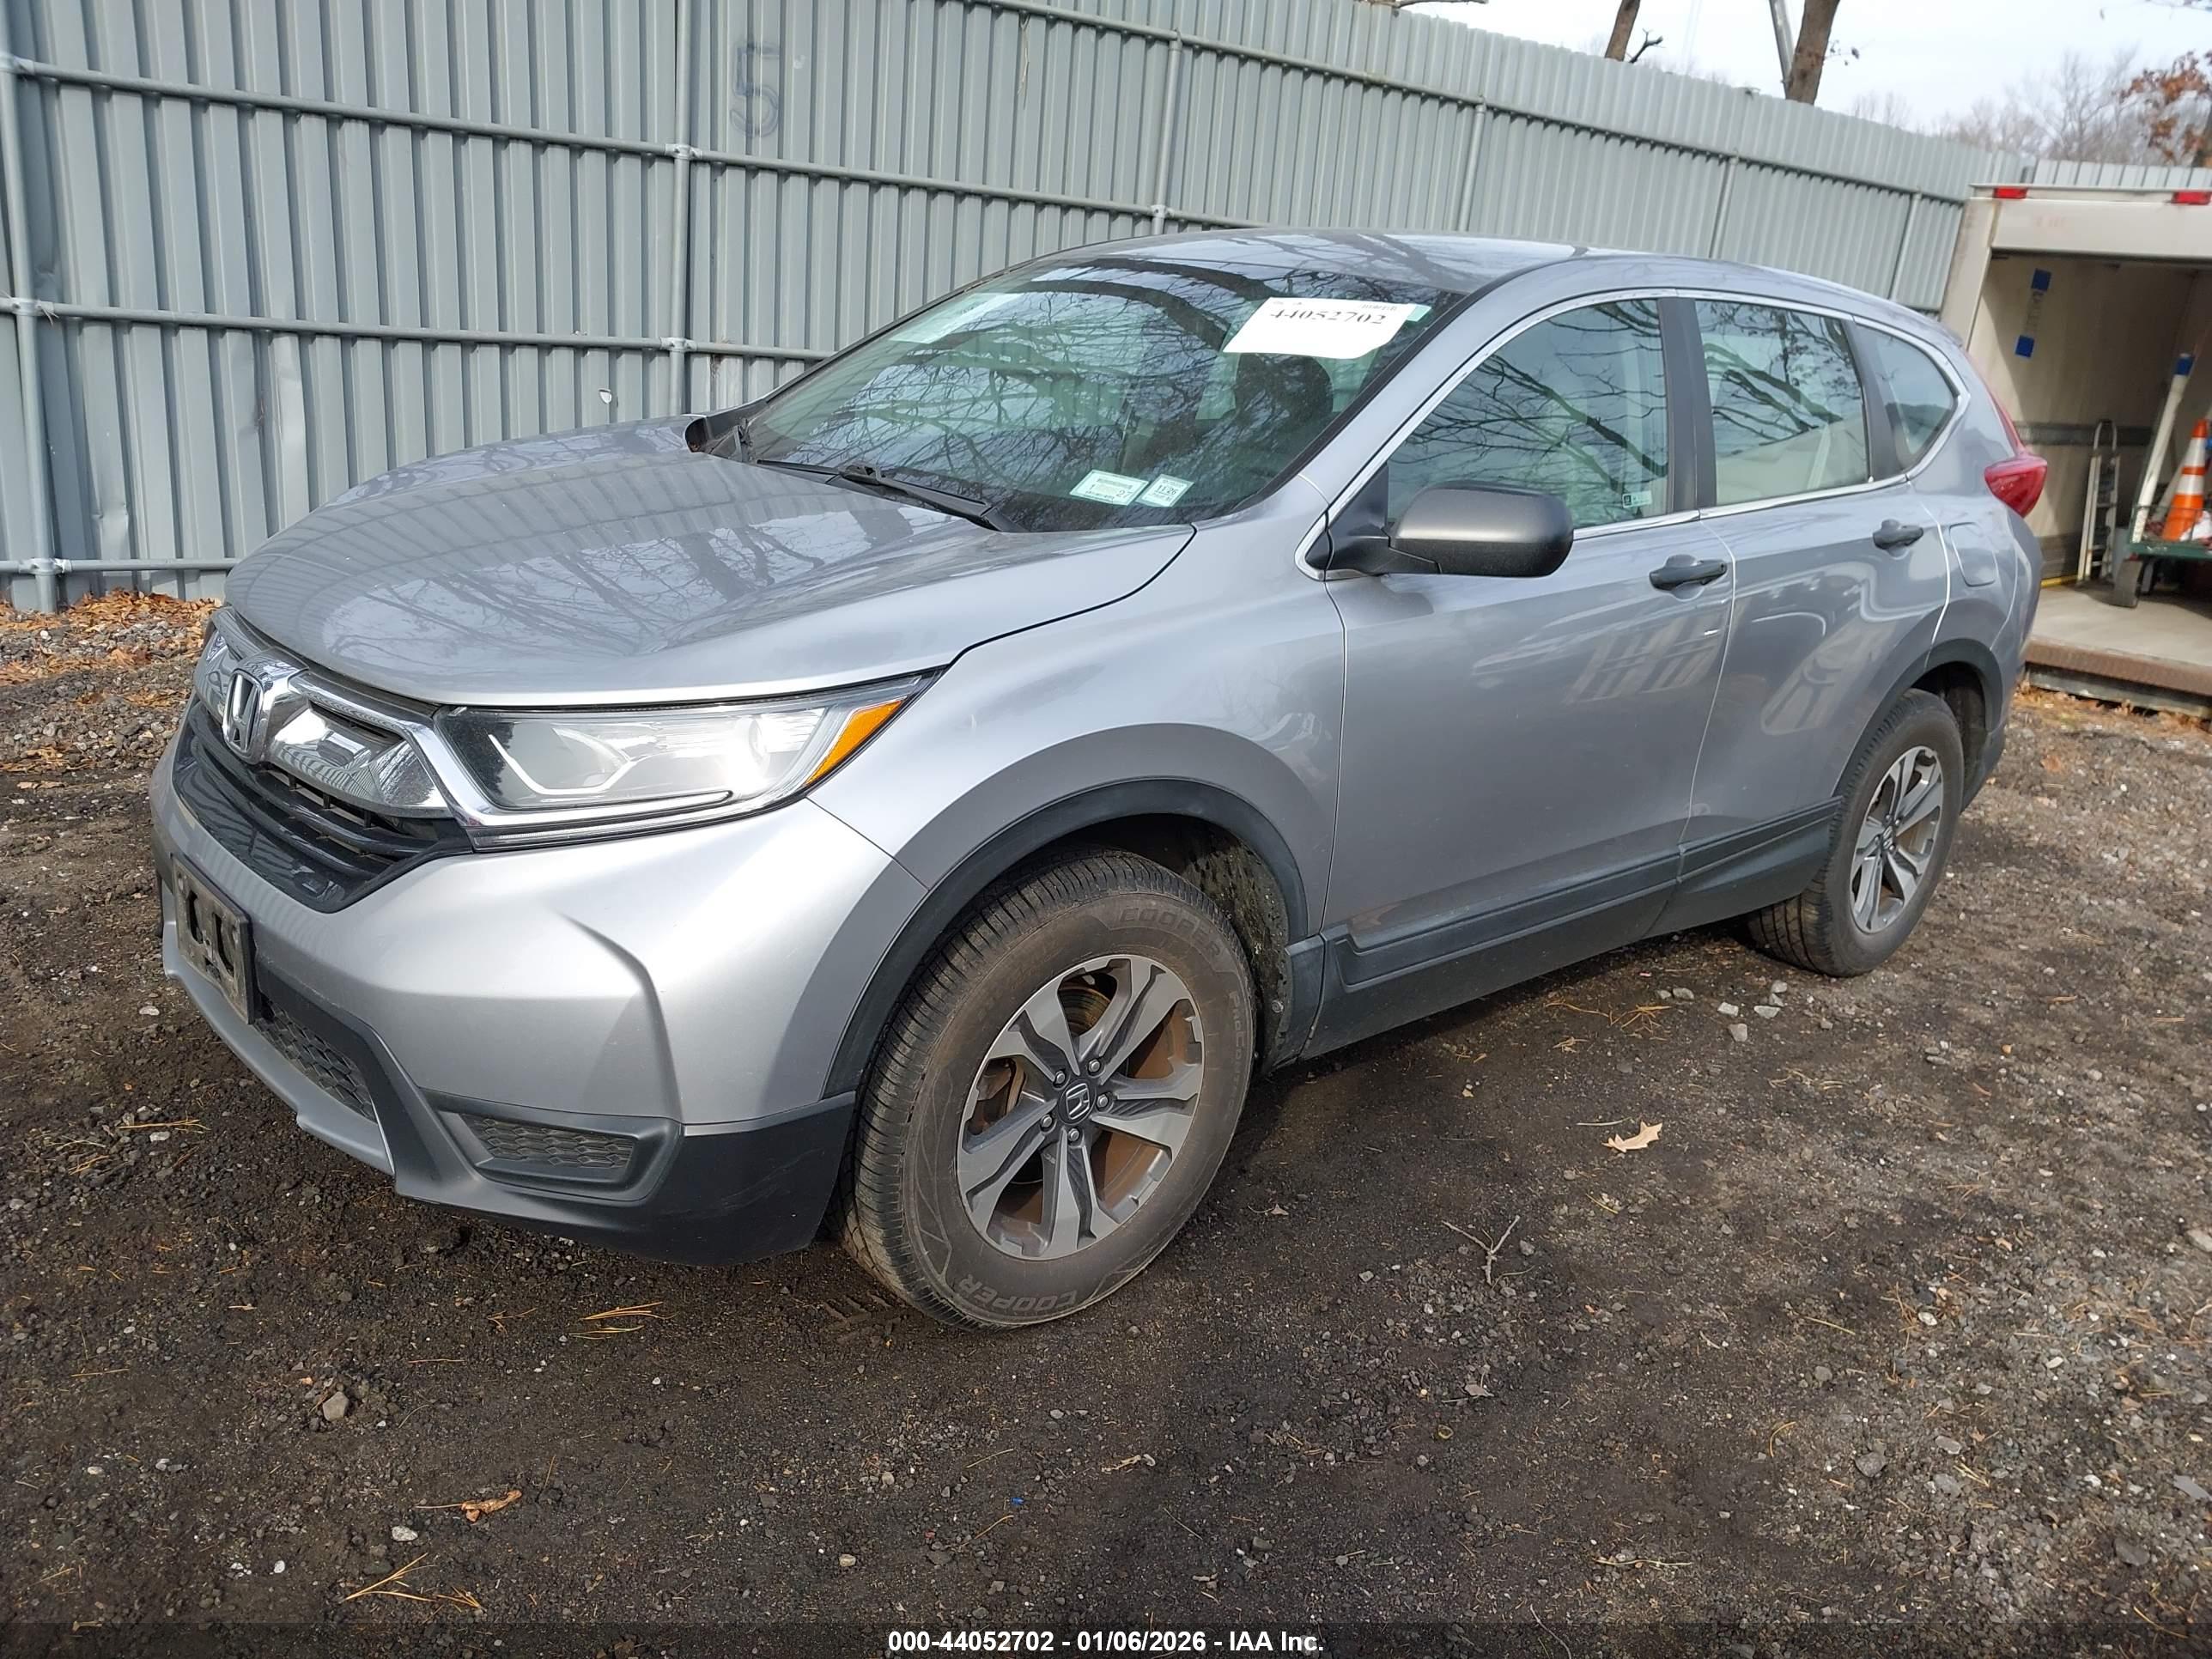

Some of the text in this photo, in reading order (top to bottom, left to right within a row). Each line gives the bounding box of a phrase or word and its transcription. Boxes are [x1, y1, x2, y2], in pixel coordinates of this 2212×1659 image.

[731, 41, 781, 138] 5
[1270, 308, 1387, 325] 44052702
[1119, 907, 1222, 957] COOPER
[958, 1273, 1078, 1313] COOPER
